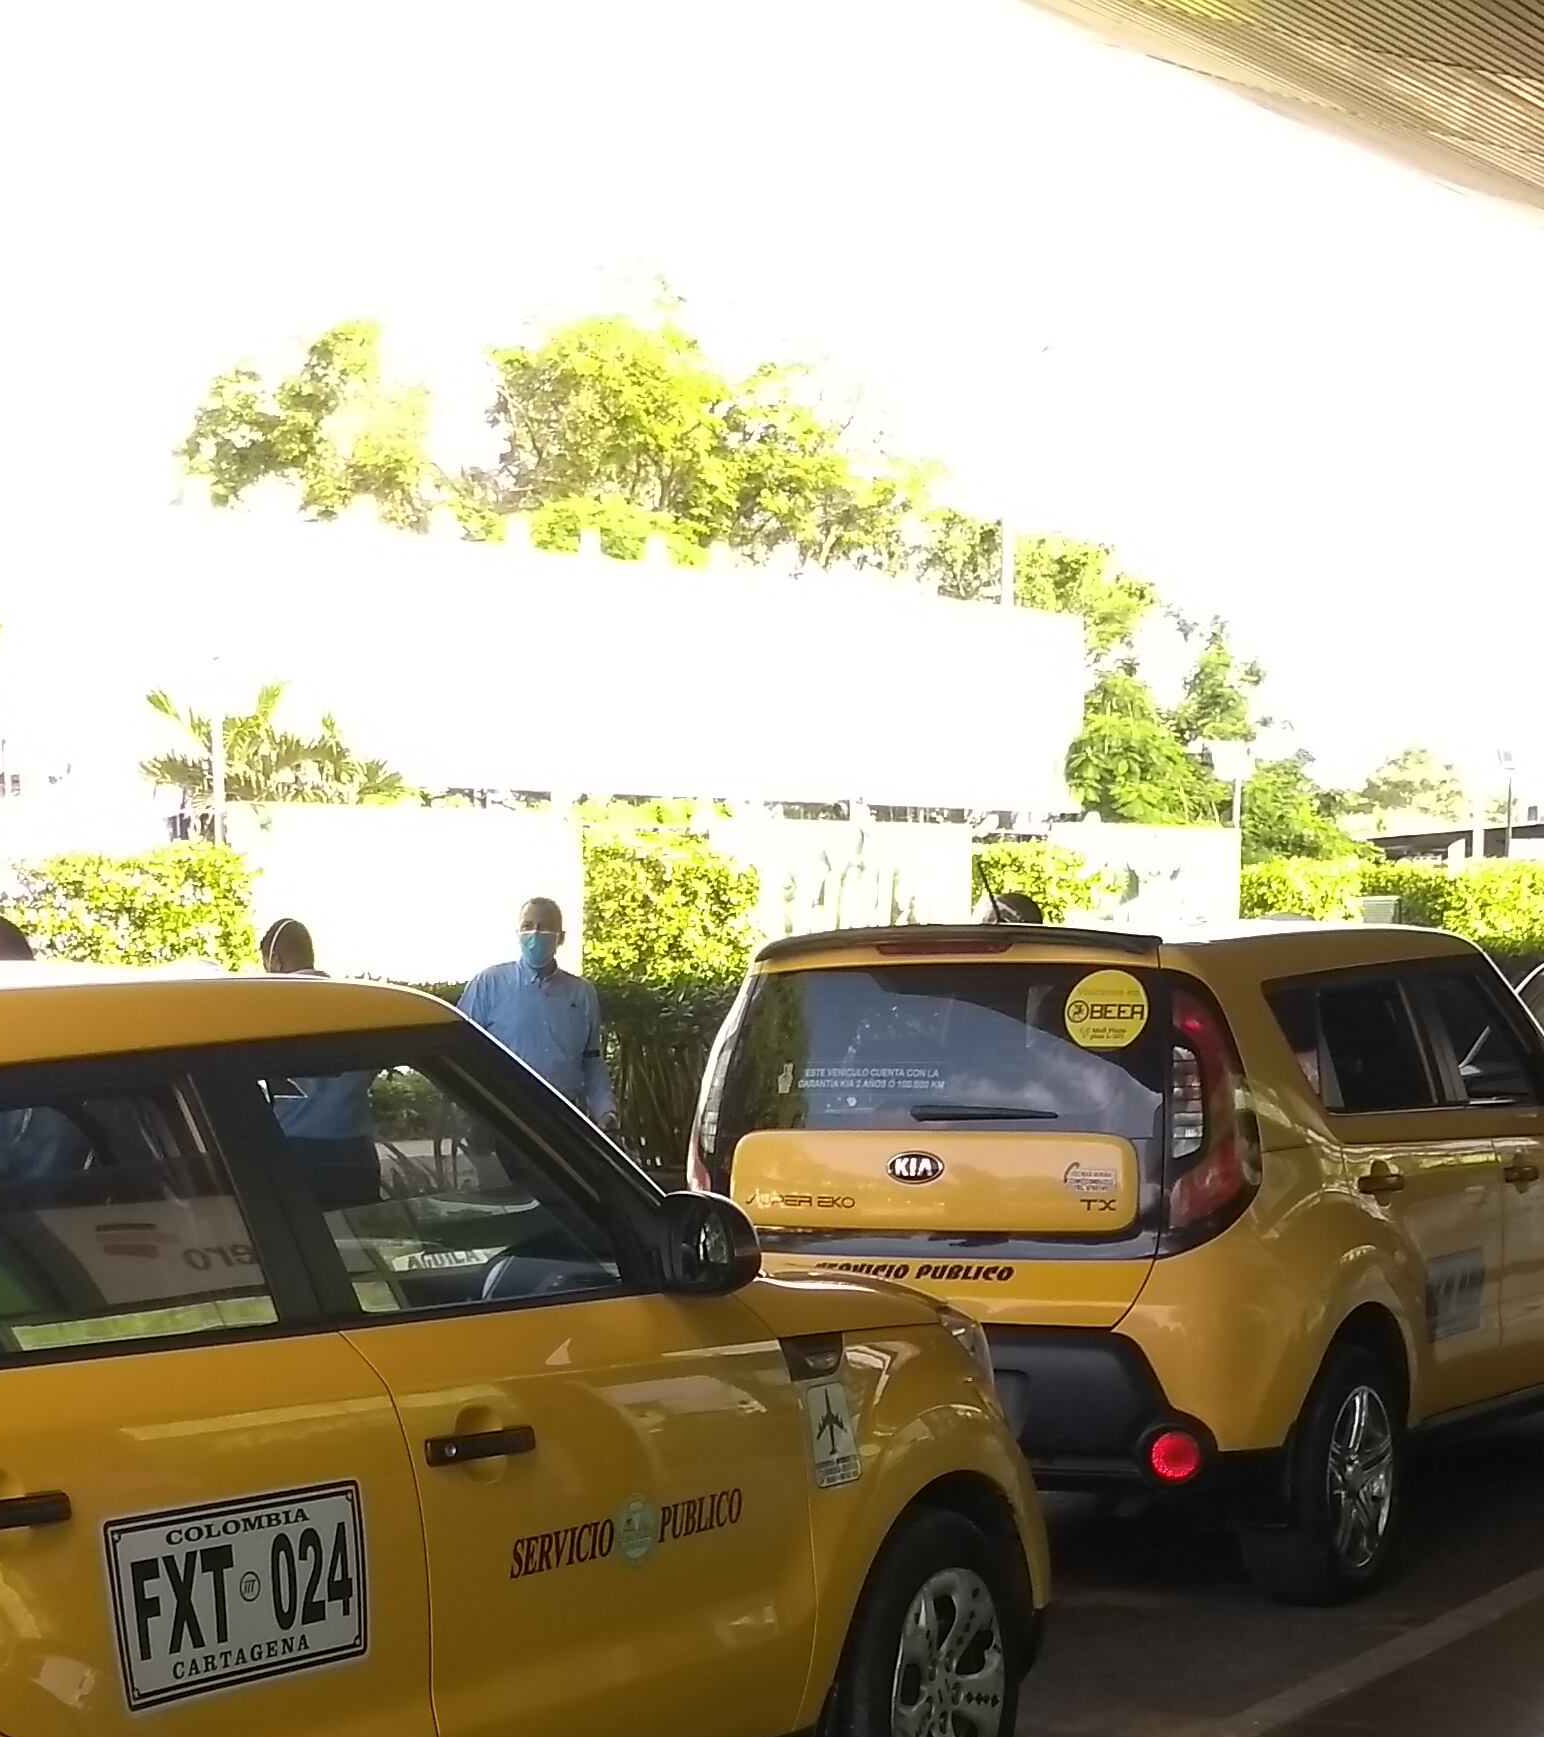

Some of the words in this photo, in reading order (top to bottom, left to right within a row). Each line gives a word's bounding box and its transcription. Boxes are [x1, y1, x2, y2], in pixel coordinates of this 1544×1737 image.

[870, 1068, 905, 1077] CUENTA
[906, 1069, 926, 1077] CON
[927, 1069, 940, 1078] LA
[894, 1157, 933, 1177] KIA
[817, 1195, 856, 1209] EKO
[1080, 1198, 1117, 1211] TX
[914, 1263, 1015, 1281] PUBLICO
[165, 1508, 311, 1546] COLOMBIA
[510, 1518, 615, 1579] SERVICIO
[658, 1488, 743, 1543] PUBLICO
[130, 1543, 235, 1661] FXT
[270, 1521, 354, 1631] 024
[172, 1633, 310, 1680] CARTAGENA
